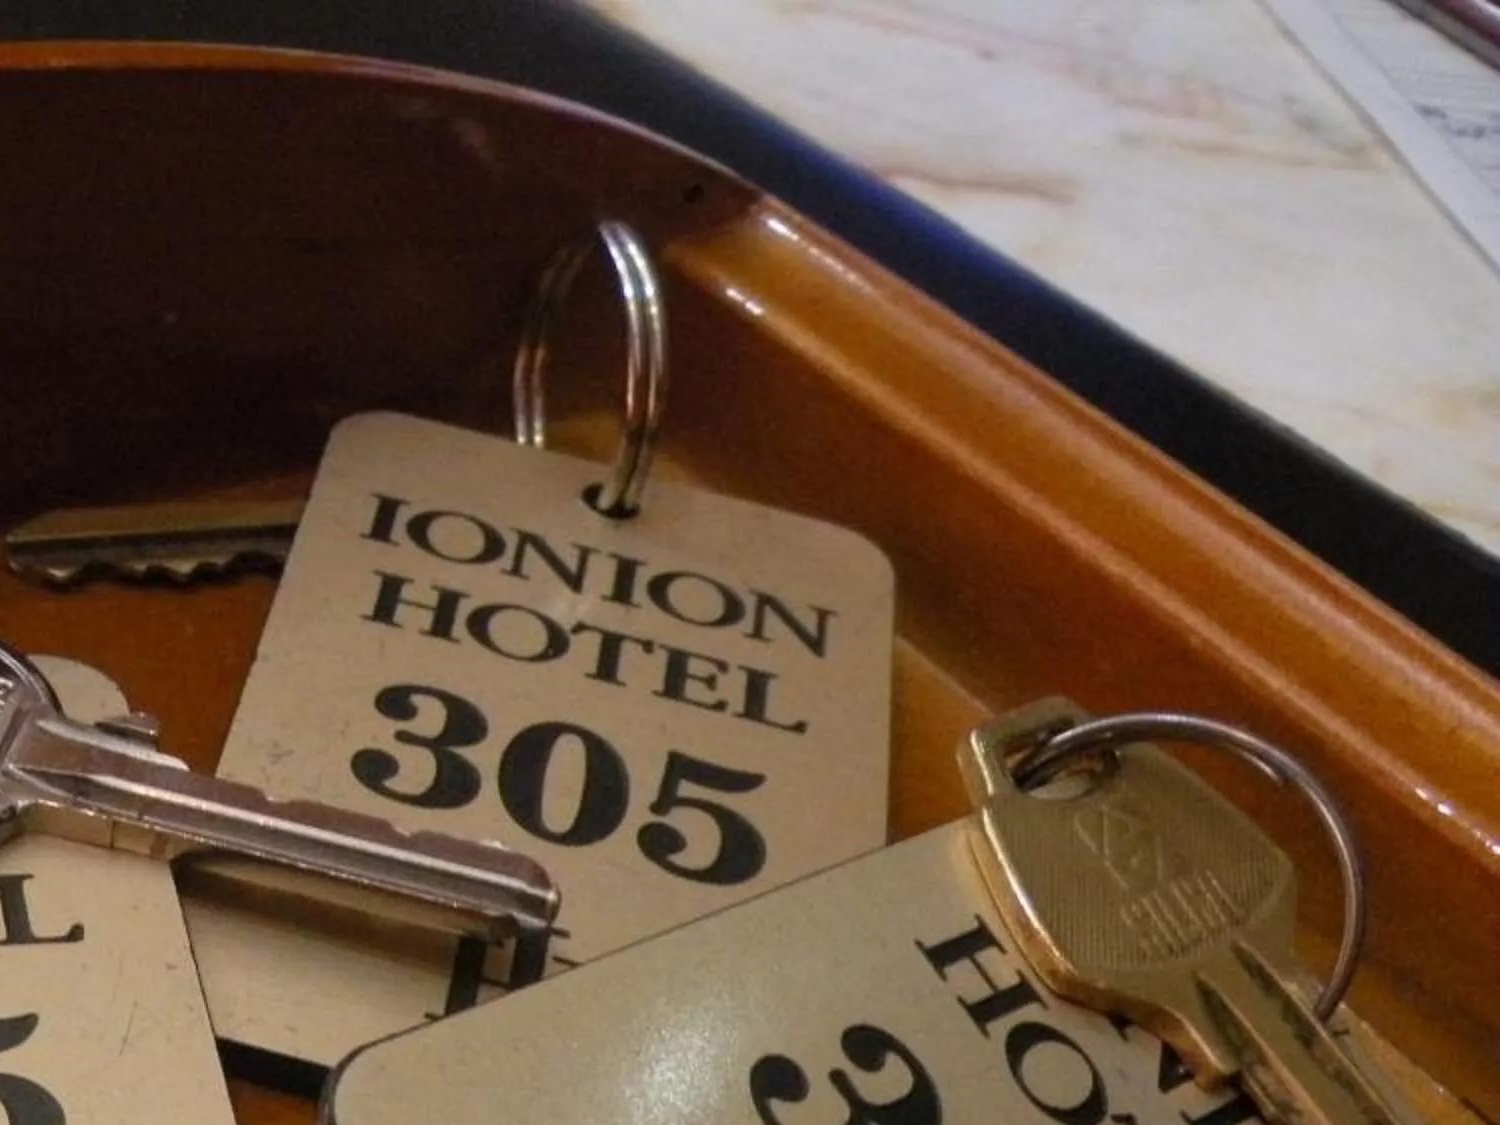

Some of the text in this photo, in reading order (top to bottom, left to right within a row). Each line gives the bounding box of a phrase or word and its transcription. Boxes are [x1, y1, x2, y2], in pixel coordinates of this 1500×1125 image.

[360, 492, 838, 657] IONION
[360, 569, 810, 735] HOTEL
[350, 683, 767, 886] 305
